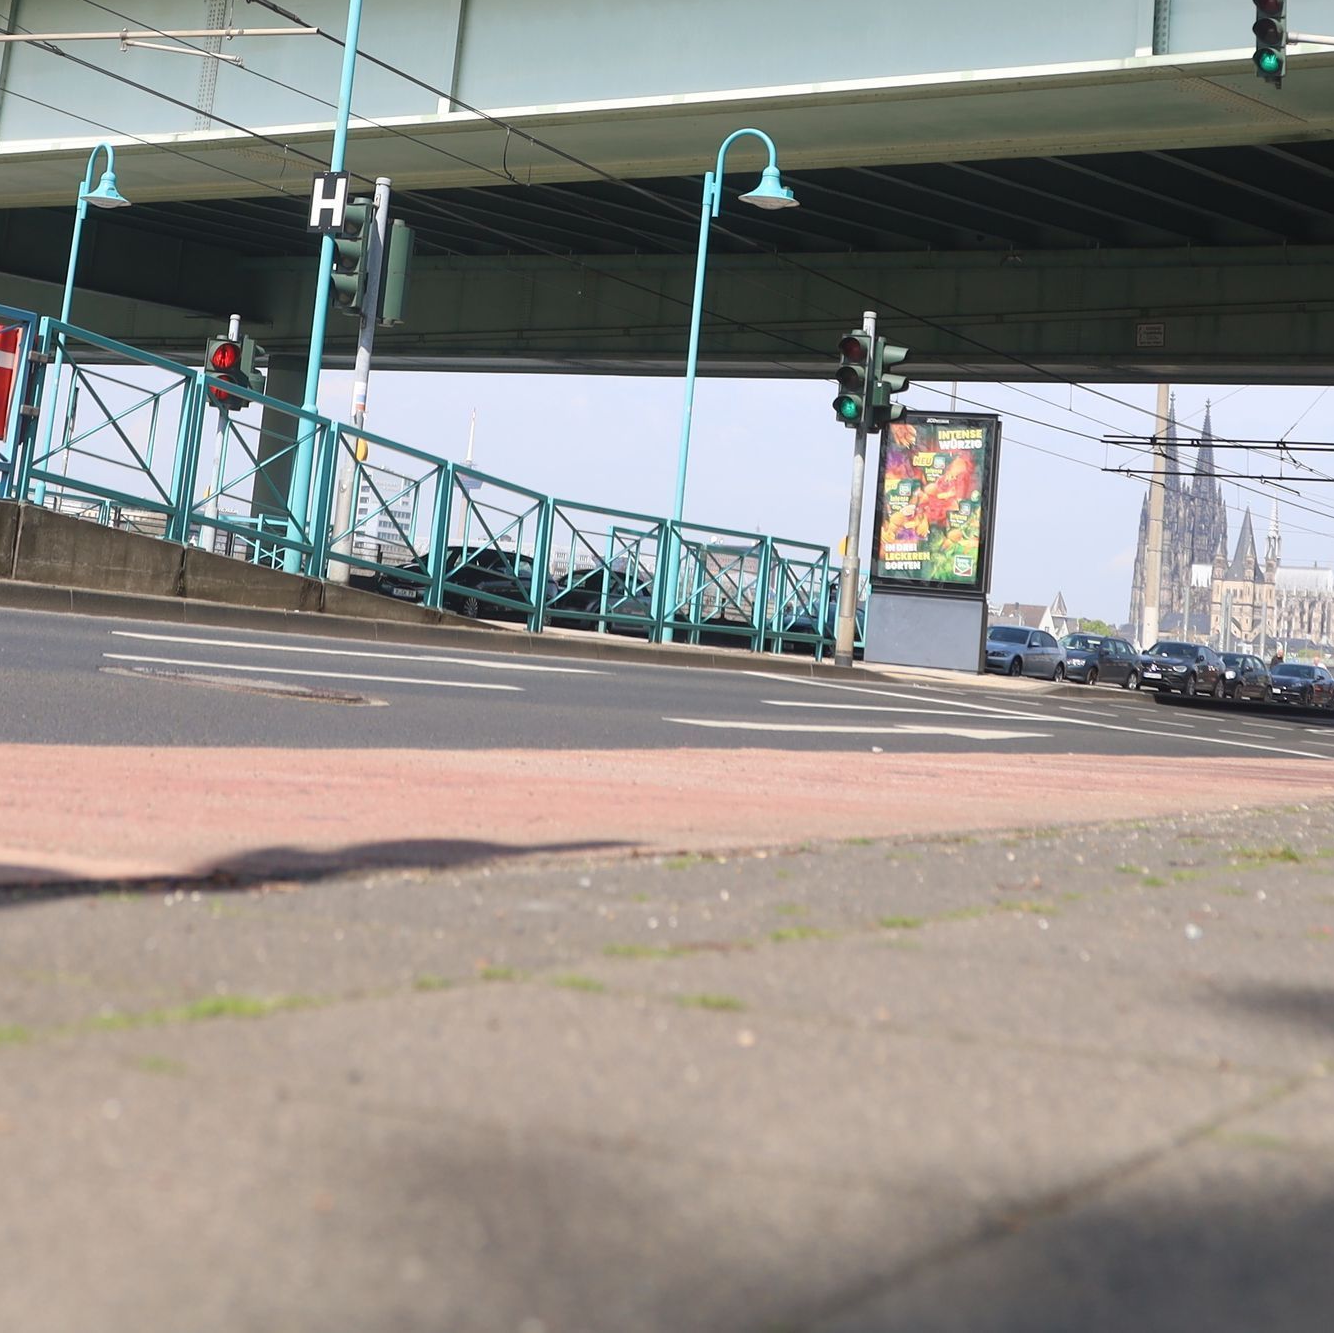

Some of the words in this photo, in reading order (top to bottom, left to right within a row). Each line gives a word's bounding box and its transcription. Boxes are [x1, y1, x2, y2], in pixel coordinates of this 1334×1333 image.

[310, 177, 347, 227] H
[938, 429, 983, 440] INTENSE
[938, 439, 983, 450] WÜRZIG
[914, 456, 933, 465] NEU
[885, 543, 895, 551] IN
[897, 543, 917, 552] DREI
[885, 551, 931, 561] LECKEREN
[885, 561, 921, 570] SORTEN
